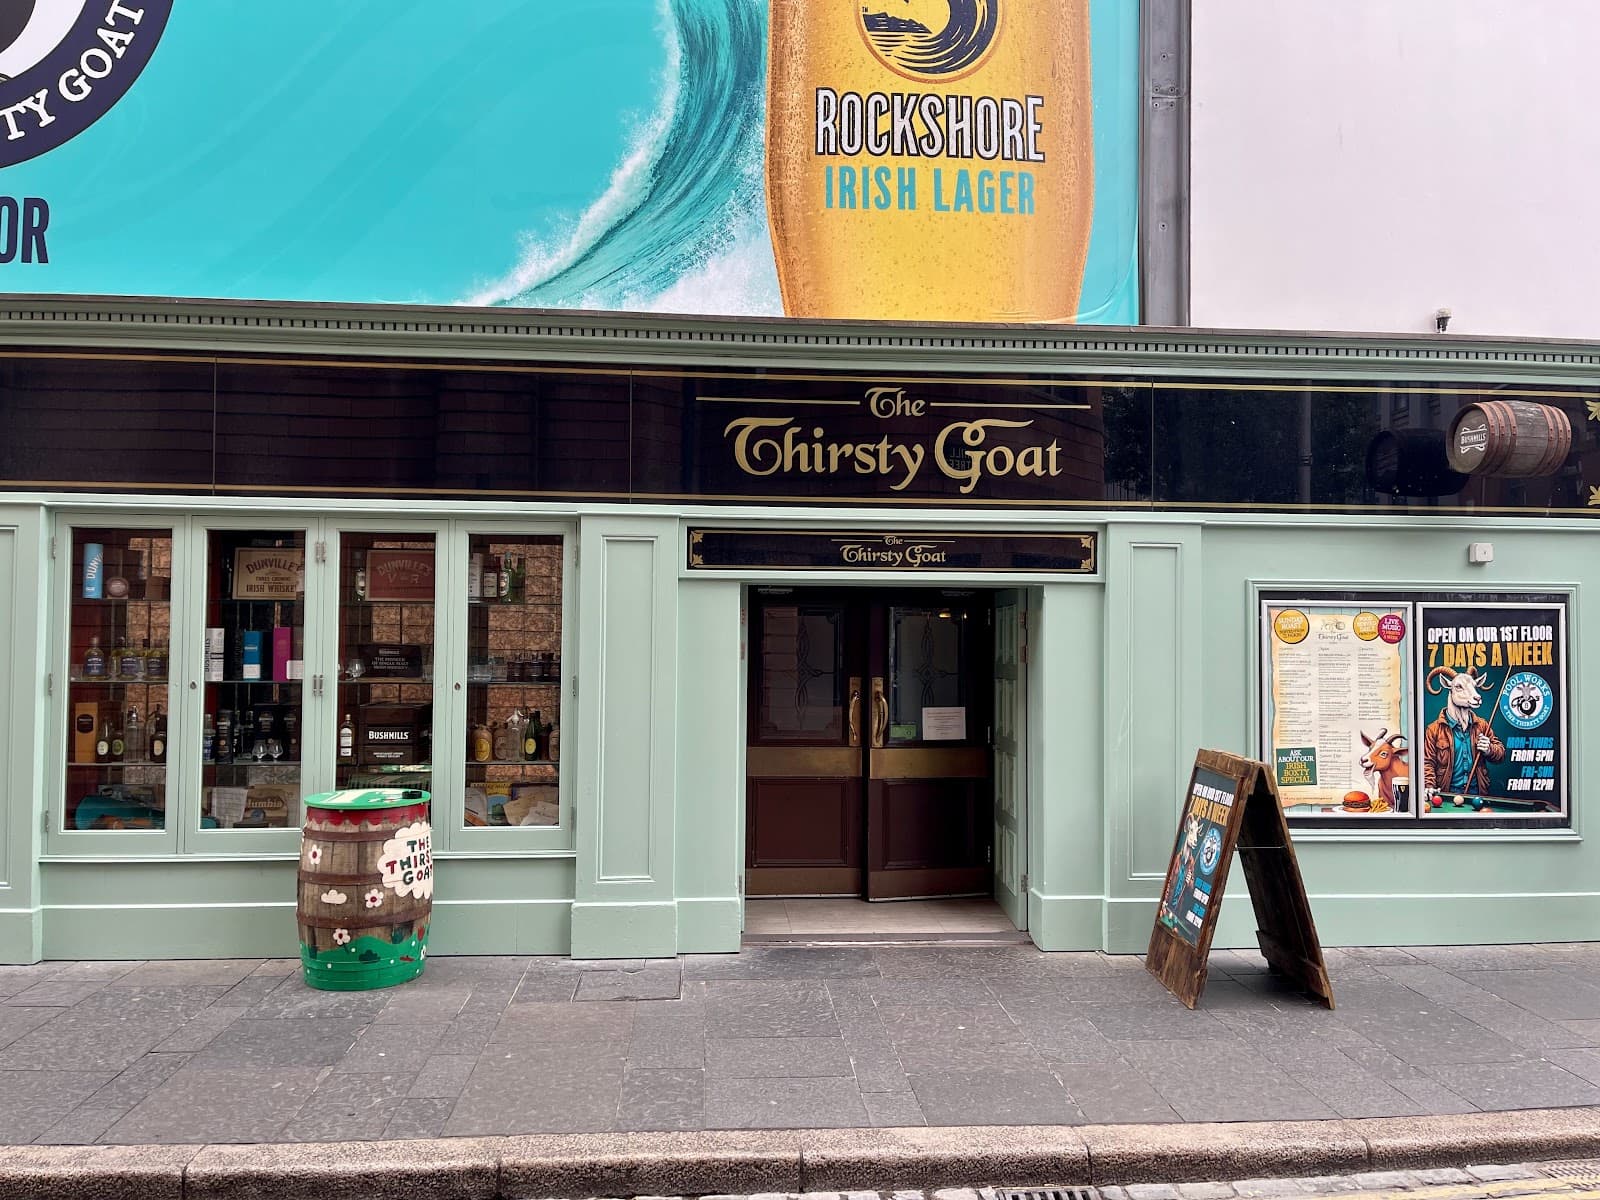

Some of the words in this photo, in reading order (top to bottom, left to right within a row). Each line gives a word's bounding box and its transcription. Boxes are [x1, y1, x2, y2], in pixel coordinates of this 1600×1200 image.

[58, 0, 144, 102] GOAT
[815, 87, 1046, 163] ROCKSHORE
[825, 165, 916, 210] IRISH
[934, 167, 1035, 215] LAGER
[865, 387, 925, 418] The
[1460, 432, 1486, 445] BUSHMILLS
[724, 416, 925, 490] Thirsty
[934, 418, 1063, 494] Goat
[883, 535, 903, 546] The
[840, 544, 903, 566] Thirsty
[905, 544, 946, 567] Goat
[268, 584, 297, 593] WHISKE
[1427, 627, 1457, 643] OPEN
[1459, 626, 1474, 643] ON
[1476, 626, 1498, 642] OUR
[1500, 626, 1518, 641] 1ST
[1521, 625, 1553, 641] FLOOR
[1427, 643, 1439, 667] 7
[1443, 643, 1487, 667] DAYS
[1491, 642, 1503, 666] A
[1506, 642, 1553, 665] WEEK
[1502, 676, 1523, 696] POOL
[1524, 674, 1551, 696] WORKS
[369, 730, 409, 740] BUSHMILLS
[1506, 736, 1554, 749] MON-THURS
[1510, 749, 1535, 762] FROM
[1535, 749, 1554, 762] 5PM
[1285, 761, 1307, 770] IRISH
[1521, 765, 1554, 778] FRI-SUN
[1283, 768, 1310, 777] BOXTY
[1280, 776, 1313, 784] SPECIAL
[1507, 778, 1532, 791] FROM
[1532, 778, 1555, 791] 12PM
[385, 850, 432, 875] THIRS
